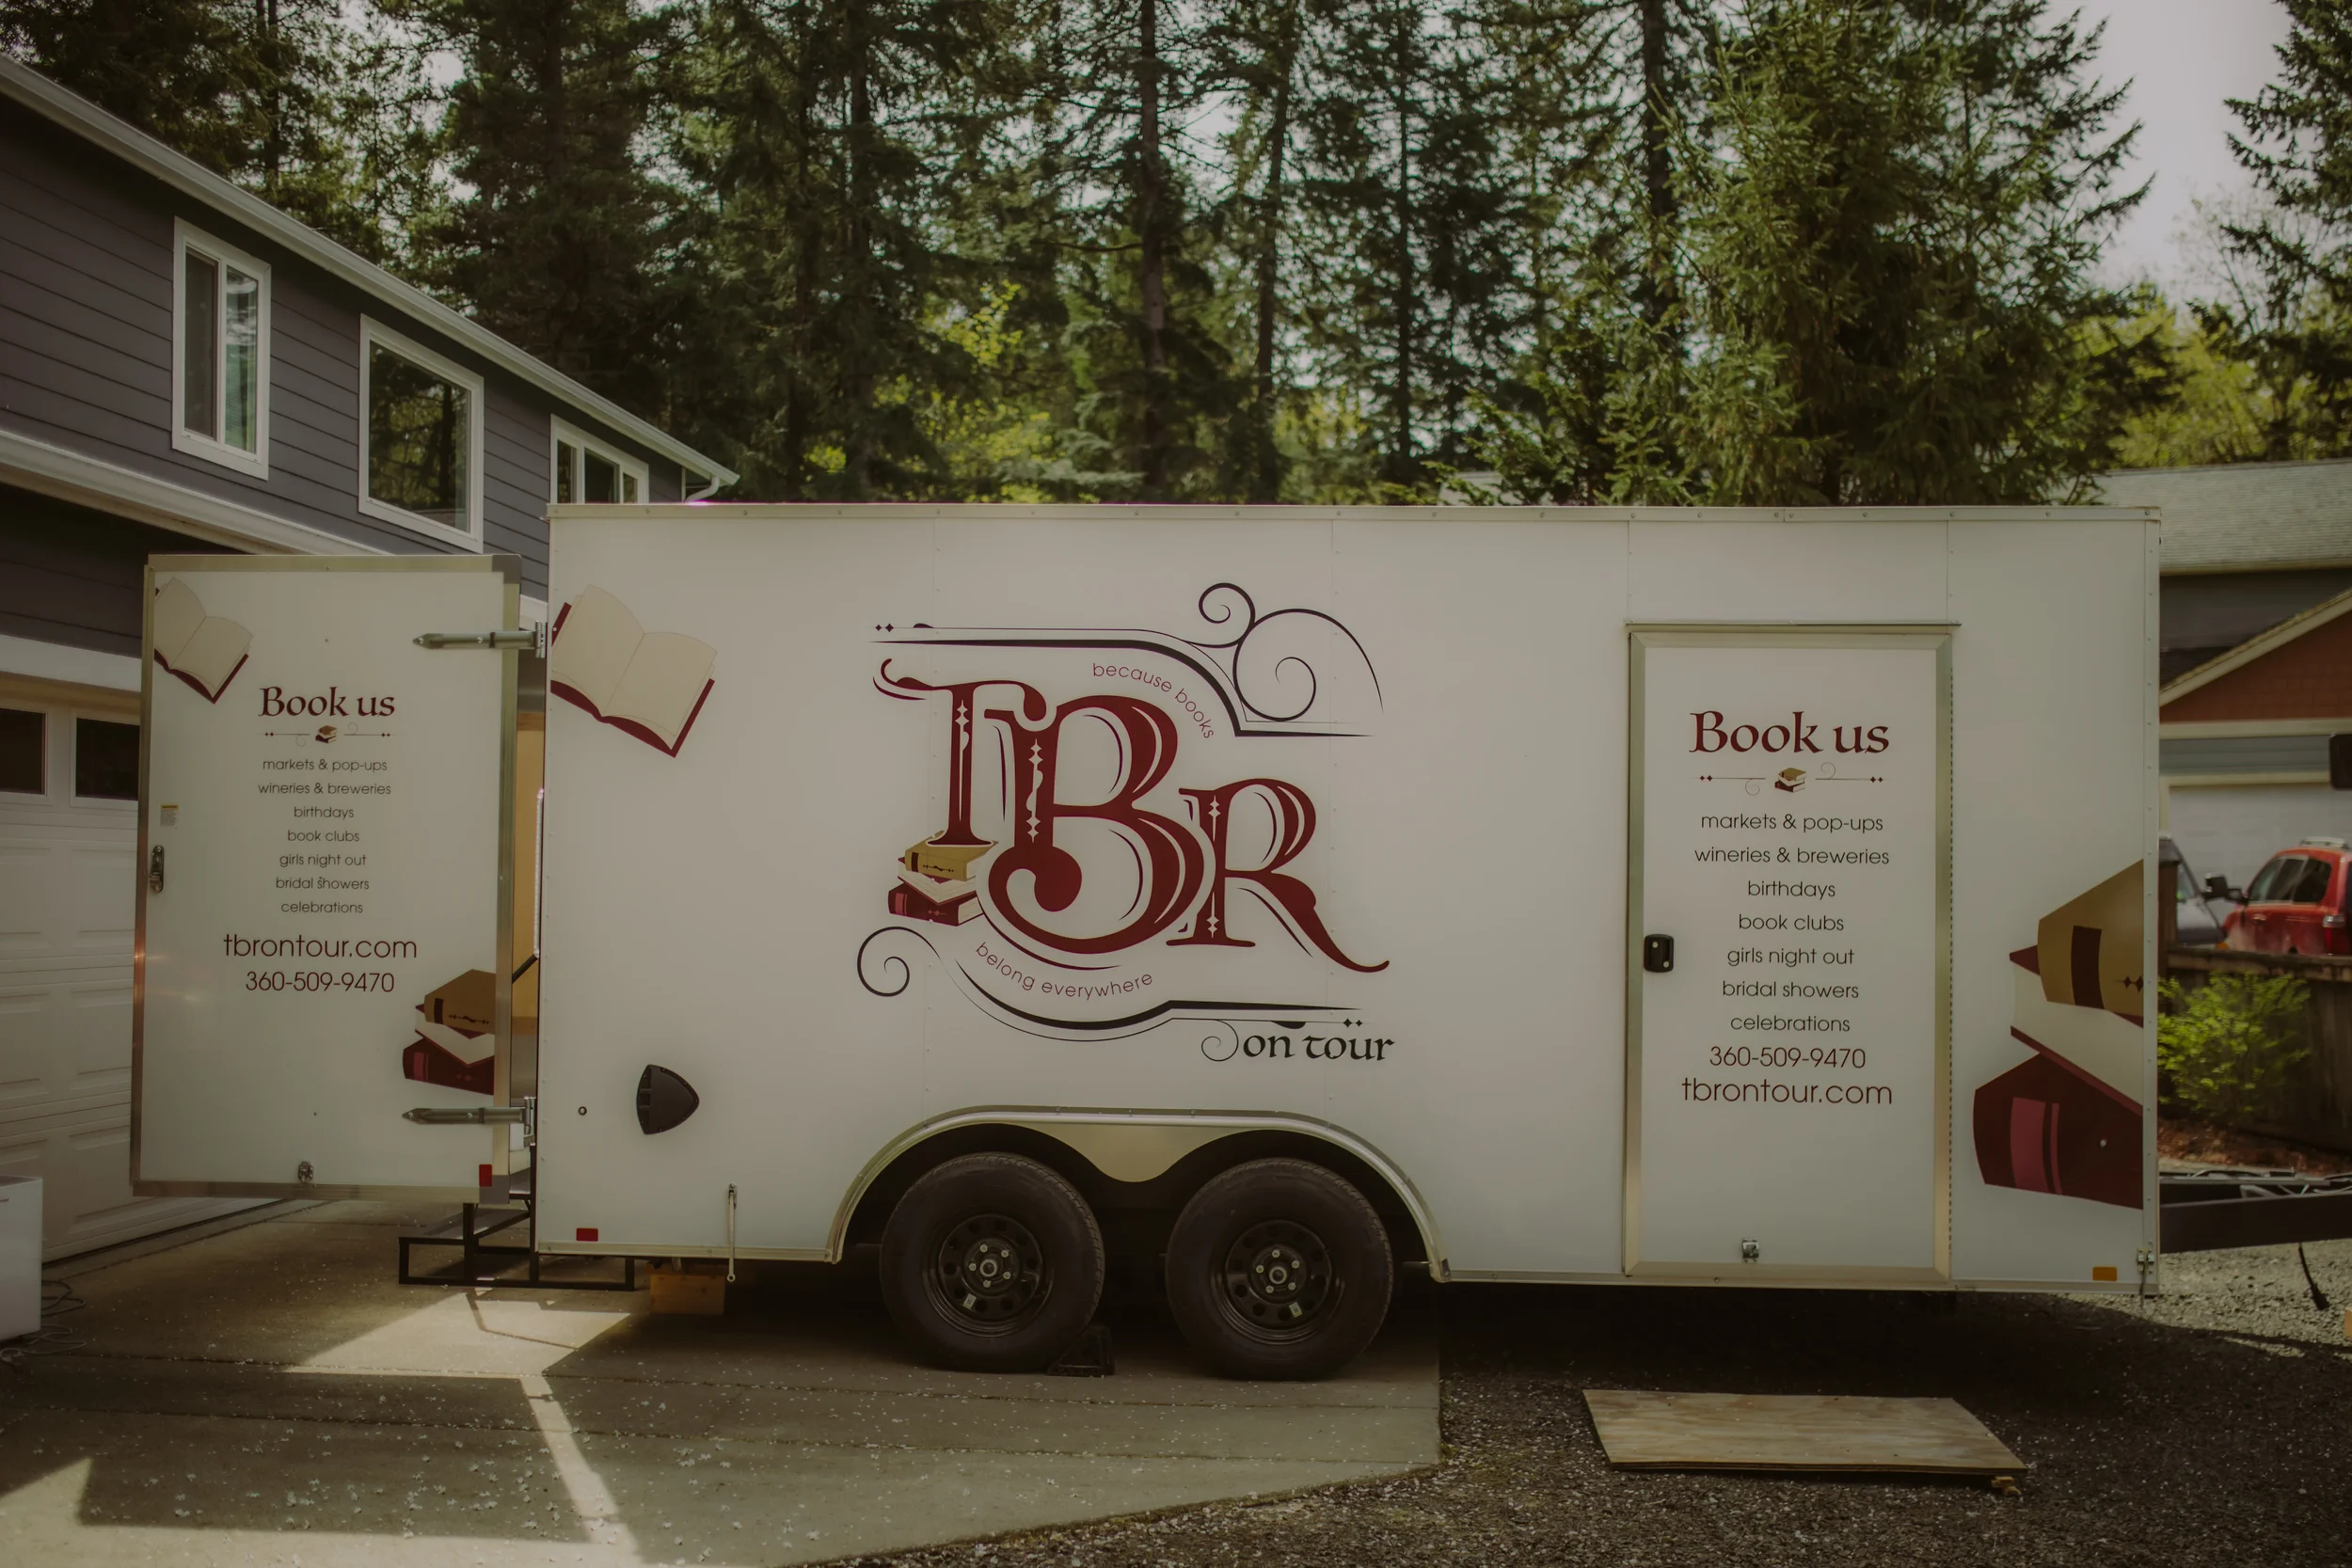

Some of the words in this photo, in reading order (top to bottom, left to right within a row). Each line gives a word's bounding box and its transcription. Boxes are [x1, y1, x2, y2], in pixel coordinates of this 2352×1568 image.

[257, 686, 350, 718] Book
[357, 696, 396, 718] us
[1092, 662, 1172, 692] because
[1174, 688, 1215, 739] books
[1688, 710, 1824, 754] Book
[1833, 724, 1890, 754] us
[262, 758, 315, 771] markets
[319, 758, 328, 771] &
[331, 759, 388, 773] pop-ups
[258, 783, 310, 795] wineries
[314, 783, 325, 795] &
[327, 783, 391, 796] breweries
[294, 805, 355, 820] birthdays
[873, 657, 1390, 974] TBR
[1701, 813, 1777, 830] markets
[1782, 813, 1798, 831] &
[1803, 816, 1883, 834] pop-ups
[287, 829, 322, 843] book
[325, 830, 360, 843] clubs
[278, 853, 305, 868] girls
[308, 853, 342, 869] night
[344, 854, 367, 867] out
[1693, 846, 1772, 863] wineries
[1776, 847, 1791, 863] &
[1797, 847, 1890, 865] breweries
[276, 877, 314, 890] bridal
[316, 876, 370, 891] showers
[1747, 879, 1836, 901] birthdays
[280, 900, 364, 914] celebrations
[1739, 913, 1788, 930] book
[1793, 914, 1845, 932] clubs
[222, 933, 418, 959] tbrontour.com
[1726, 946, 1764, 968] girls
[1768, 947, 1818, 968] night
[1822, 948, 1855, 965] out
[245, 970, 395, 993] 360-509-9470
[975, 942, 1036, 991] belong
[1041, 974, 1152, 1001] everywhere
[1722, 979, 1777, 998] bridal
[1782, 981, 1860, 999] showers
[1730, 1014, 1851, 1033] celebrations
[1708, 1045, 1867, 1069] 360-509-9470
[1680, 1076, 1893, 1105] tbrontour.com
